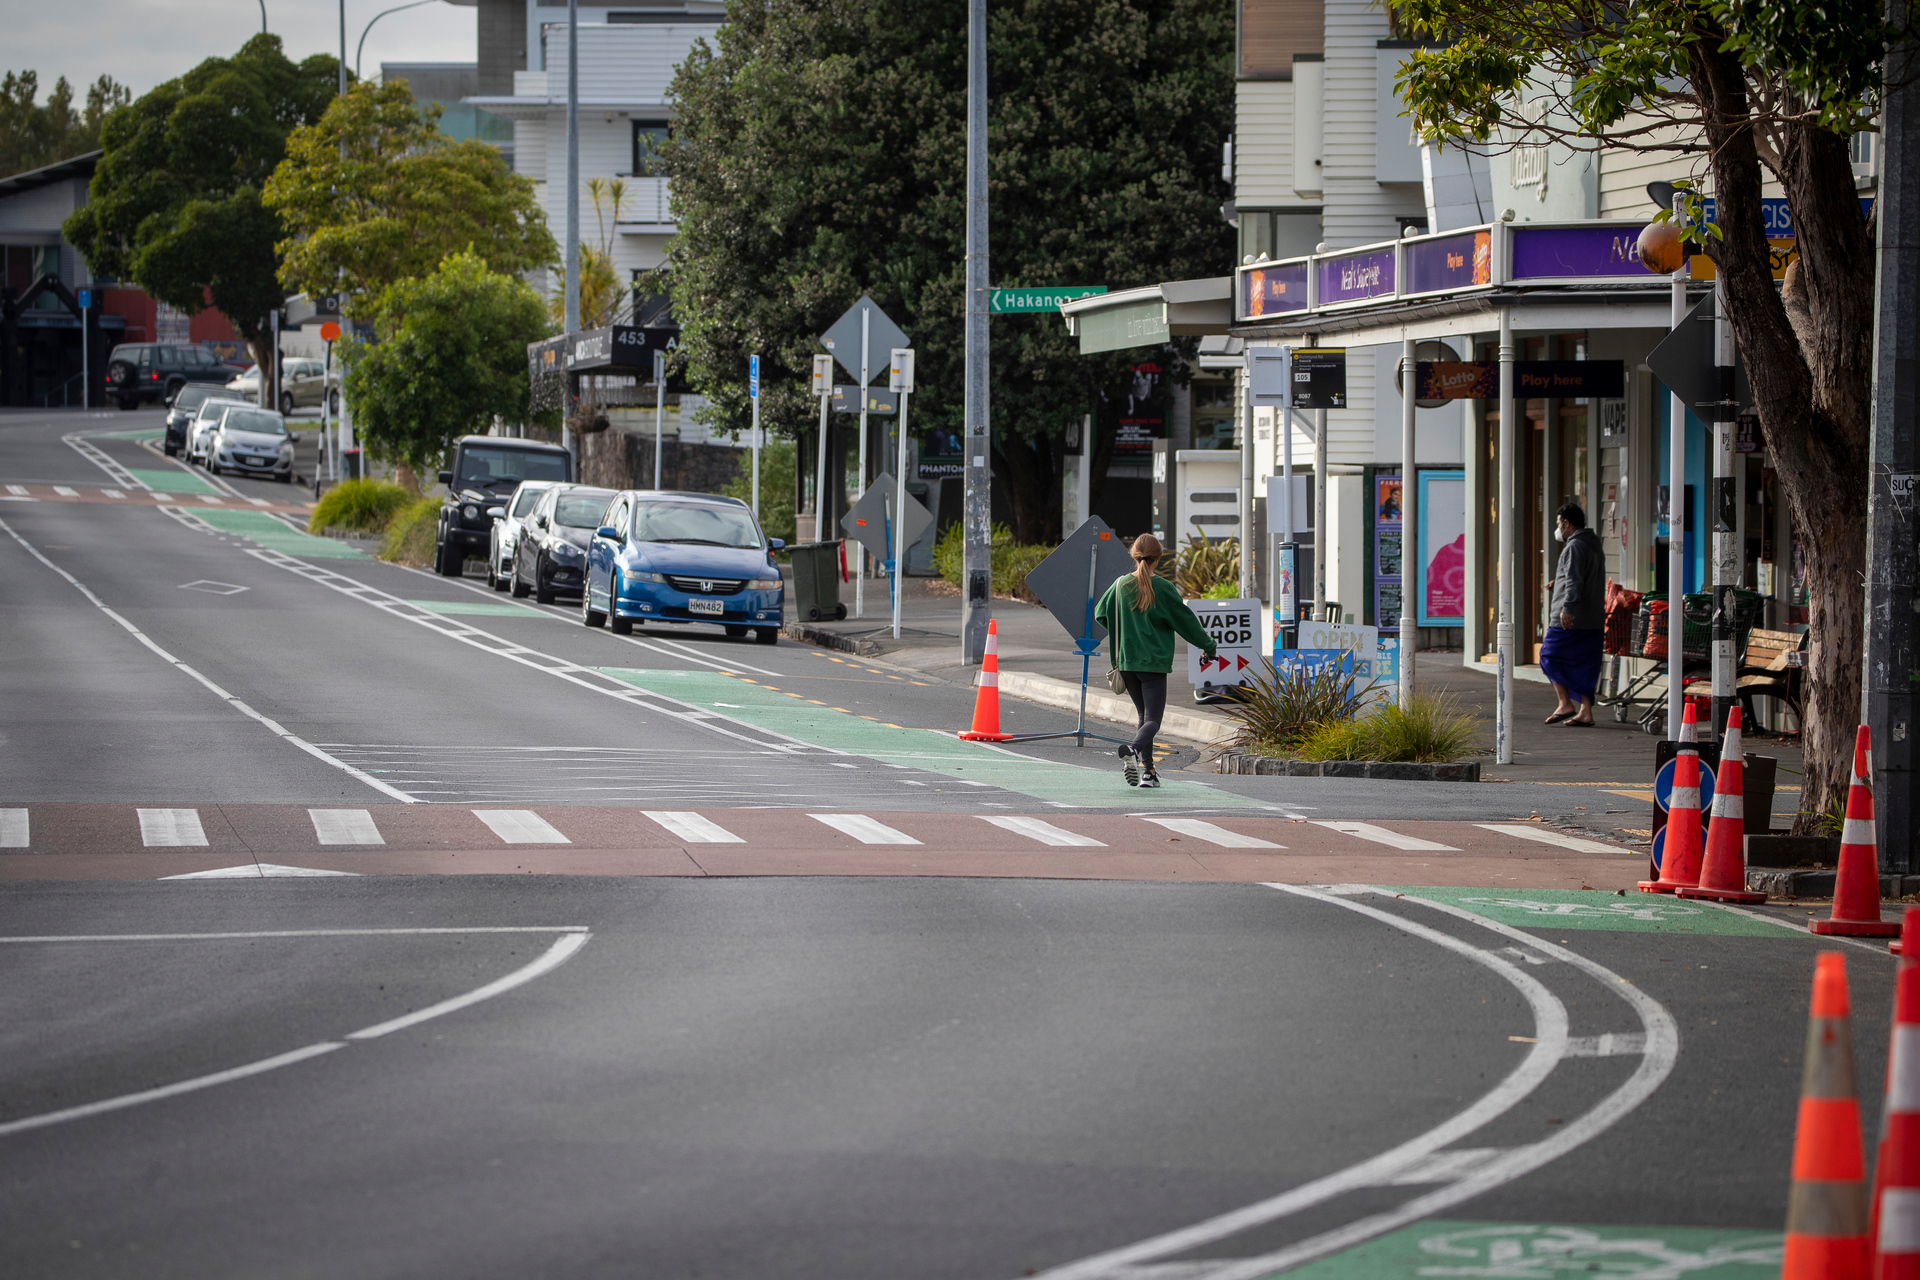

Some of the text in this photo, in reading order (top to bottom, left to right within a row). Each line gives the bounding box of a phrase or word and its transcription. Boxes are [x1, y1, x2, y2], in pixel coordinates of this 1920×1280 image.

[1447, 252, 1456, 272] Play
[1455, 252, 1464, 268] here
[618, 331, 646, 345] 453
[1442, 372, 1475, 386] Lotto
[1522, 374, 1582, 388] Play here
[690, 601, 722, 612] HMN482
[1198, 614, 1250, 628] VAPE
[1210, 630, 1252, 644] HOP
[1312, 630, 1363, 653] OPEN
